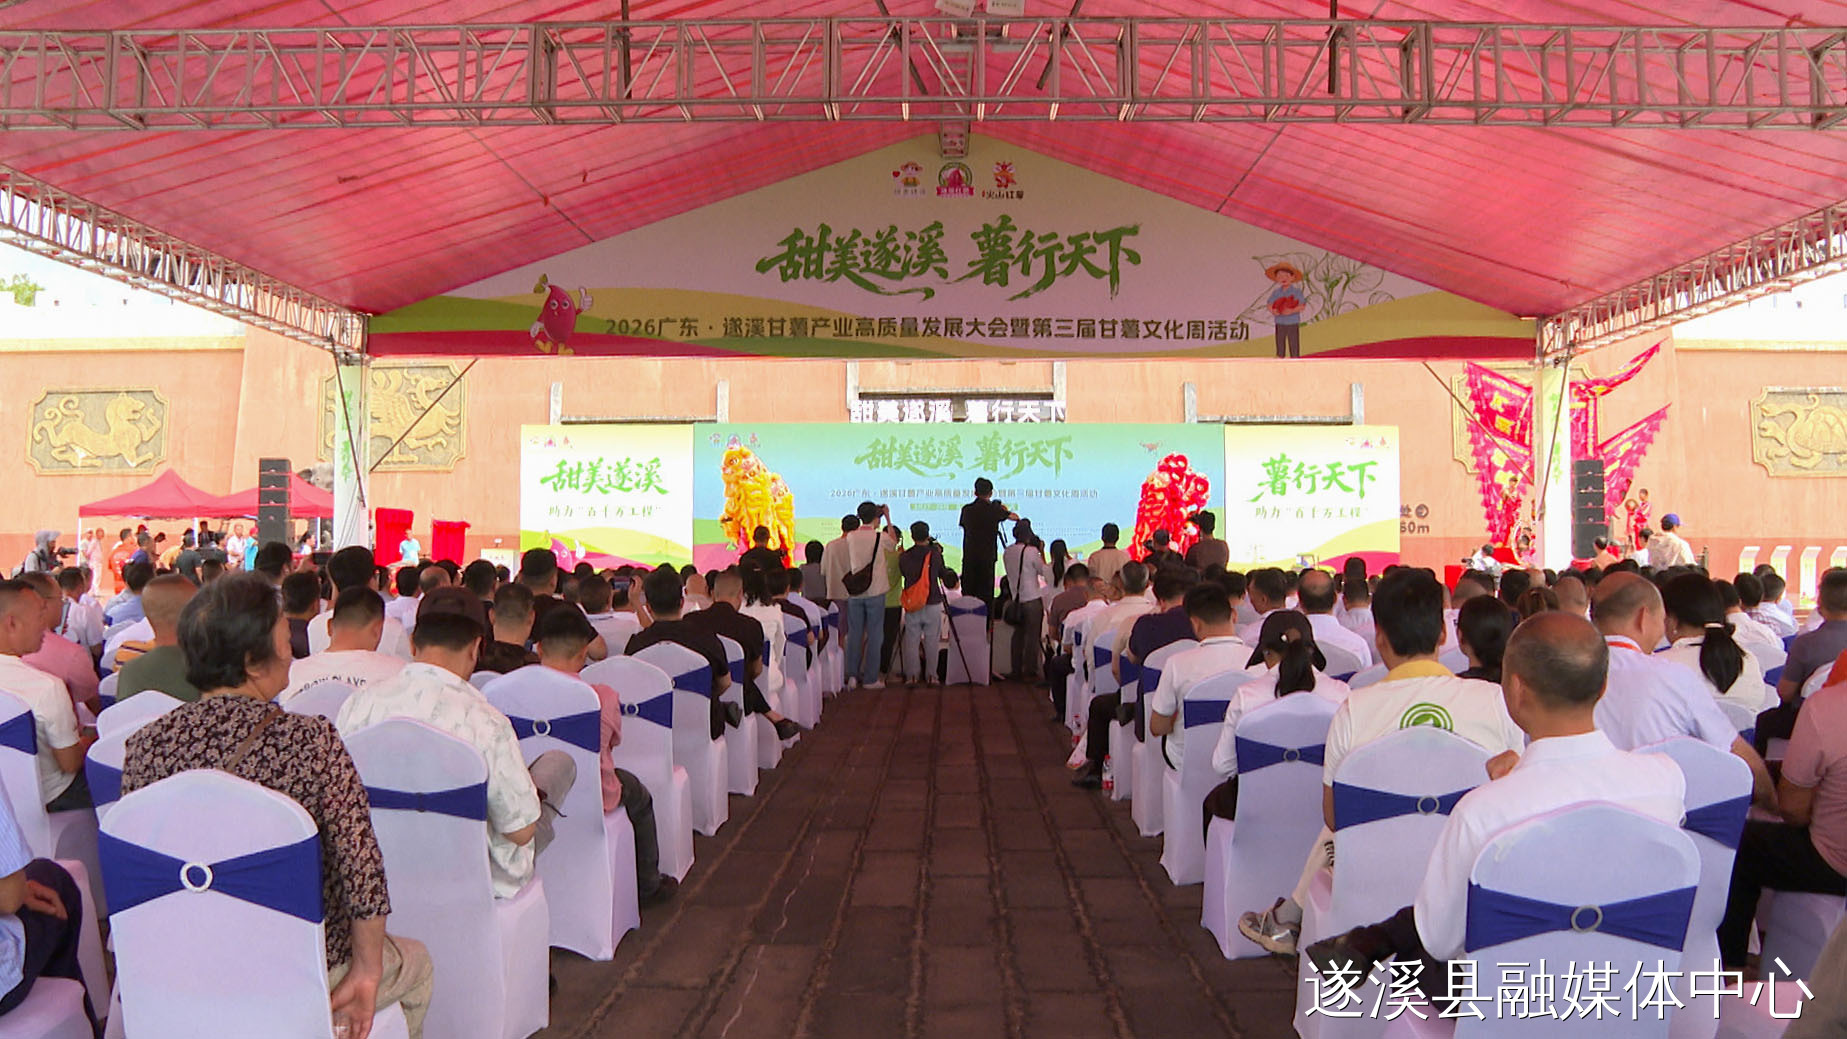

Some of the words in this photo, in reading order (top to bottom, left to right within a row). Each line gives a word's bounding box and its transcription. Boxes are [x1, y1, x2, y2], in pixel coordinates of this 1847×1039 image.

[755, 219, 949, 301] 甜美遂溪
[949, 214, 1142, 302] 薯行天下
[540, 456, 670, 495] 甜美遂溪
[853, 434, 964, 480] 甜美遂溪
[966, 430, 1075, 480] 薯行天下
[1247, 452, 1379, 502] 薯行天下
